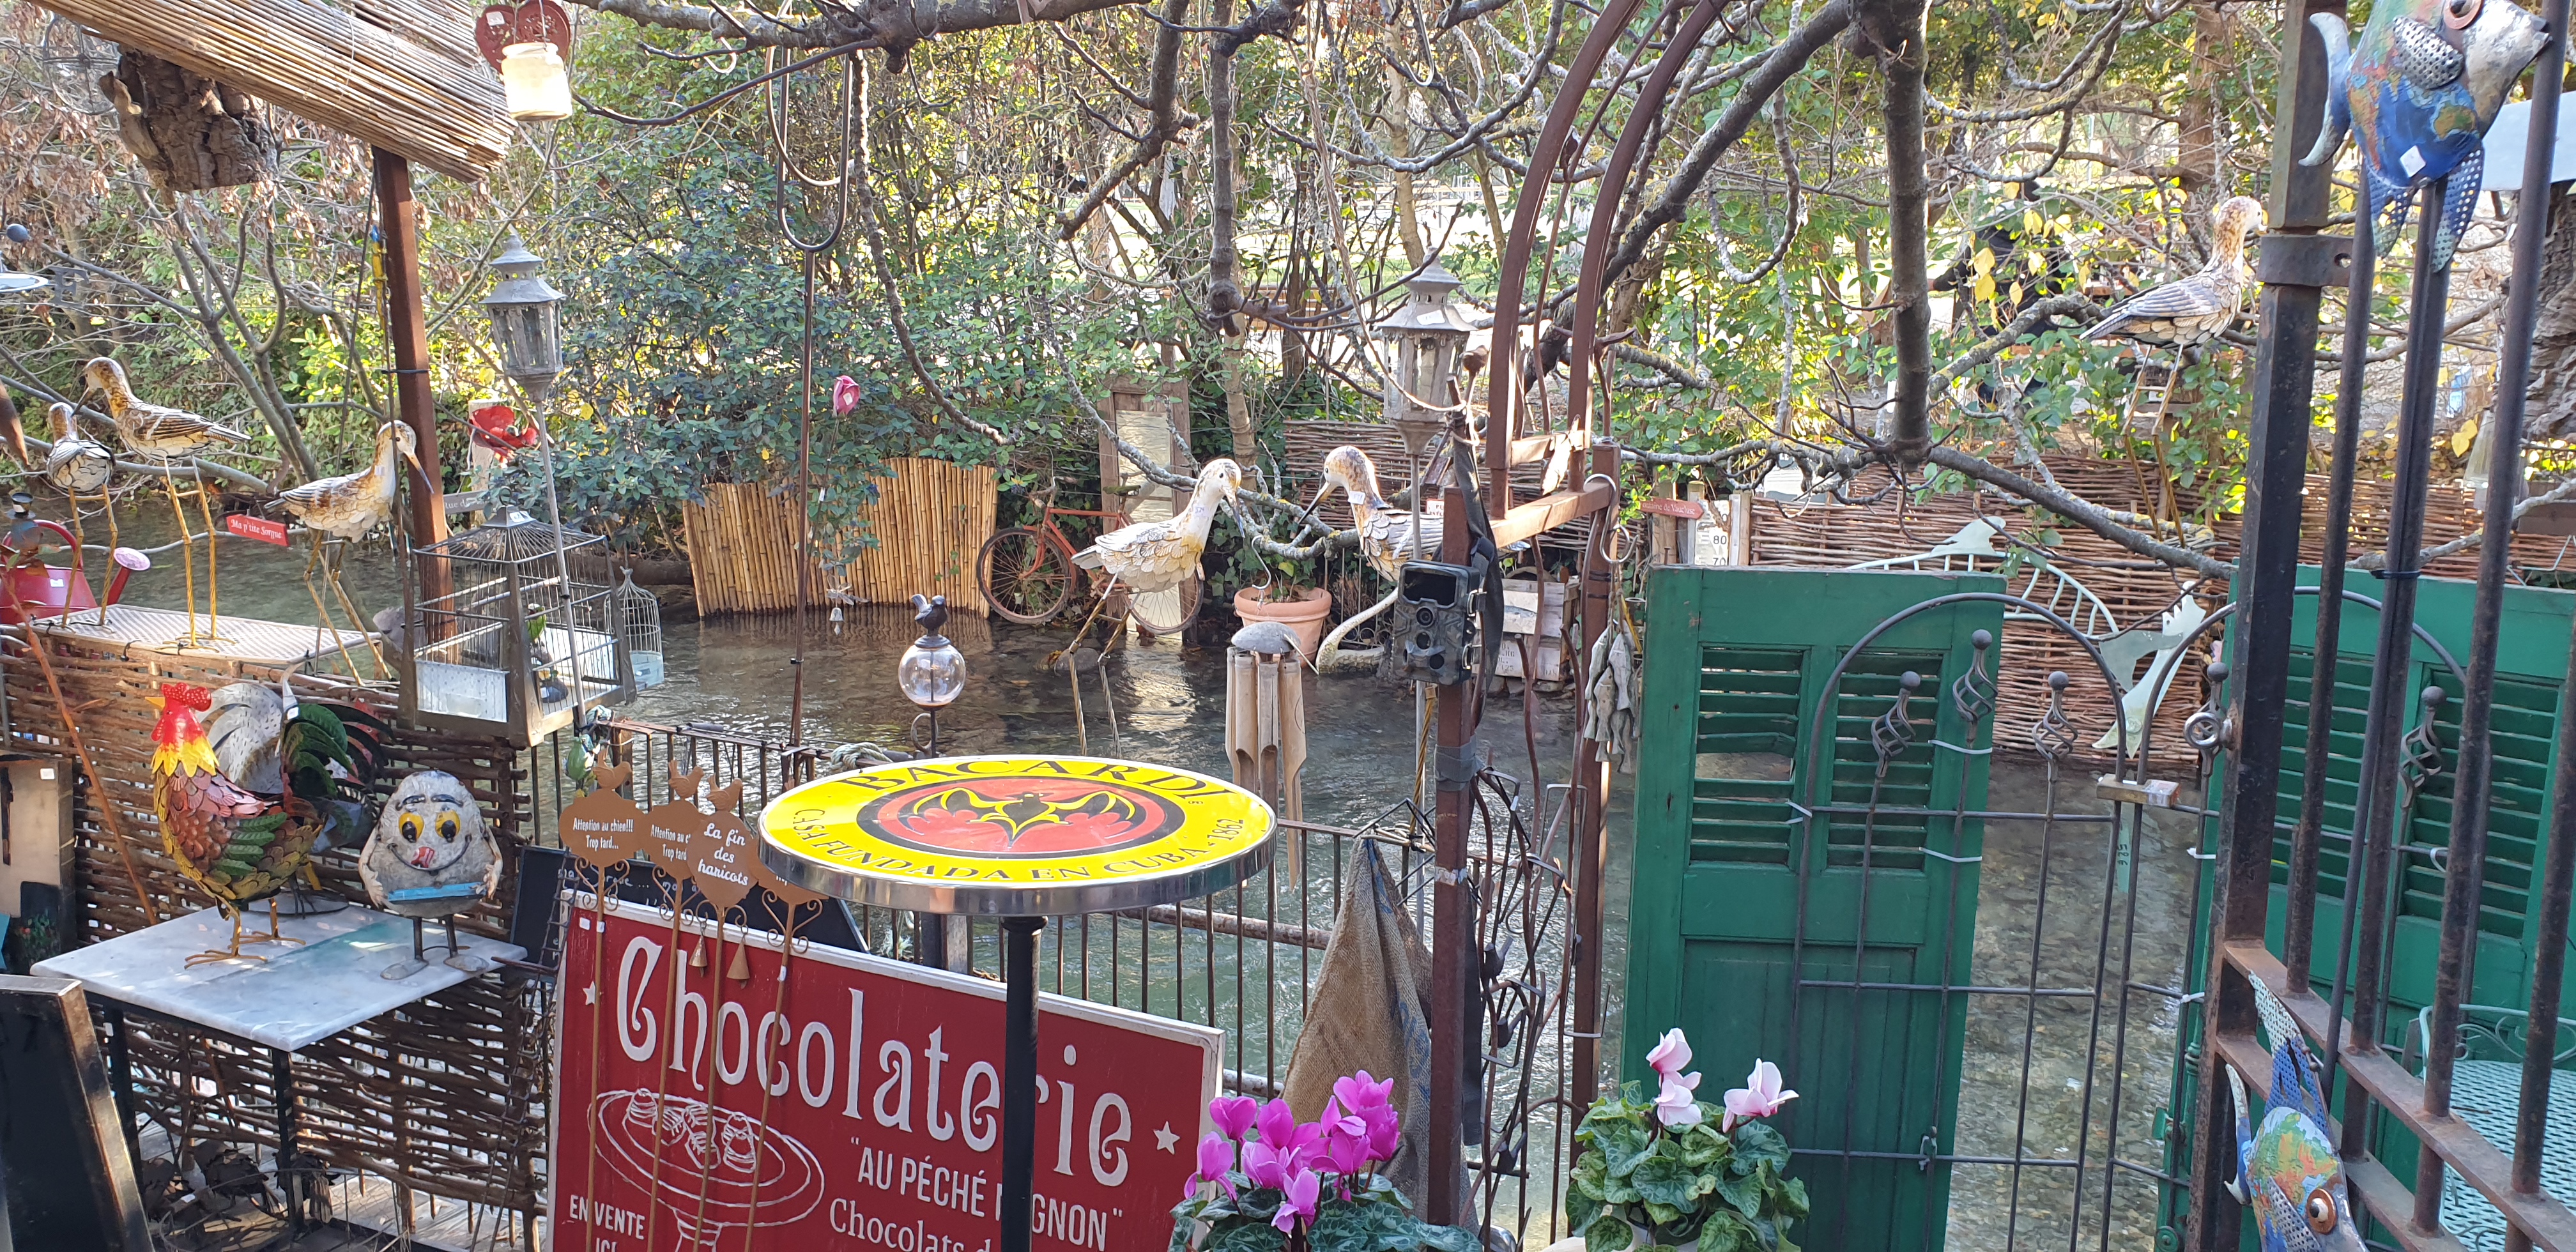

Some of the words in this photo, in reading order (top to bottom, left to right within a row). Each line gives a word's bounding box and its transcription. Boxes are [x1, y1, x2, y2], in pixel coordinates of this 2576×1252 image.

[1643, 502, 1662, 510] ontaine
[231, 519, 243, 530] Ma
[261, 526, 282, 540] Sorgue
[1713, 535, 1727, 545] 80
[1713, 557, 1726, 566] 70
[839, 760, 1238, 800] BACARDI
[572, 817, 600, 832] Attention
[602, 820, 609, 832] au
[610, 818, 634, 832] chien!!!
[650, 824, 676, 842] Attention
[677, 832, 685, 843] au
[703, 822, 723, 840] La
[725, 828, 746, 847] fin
[586, 834, 599, 852] Trop
[601, 836, 619, 850] tard...
[662, 843, 675, 862] Trop
[792, 809, 829, 841] CASA
[811, 839, 1013, 881] FUNDADA
[1031, 866, 1092, 880] EN
[1103, 847, 1211, 874] CUBA
[1206, 818, 1244, 841] 1862
[714, 846, 735, 864] des
[698, 858, 749, 887] haricots
[617, 936, 1132, 1187] Chocolateie
[900, 1154, 987, 1218] PÉCHÉ
[995, 1182, 1123, 1252] GNON"
[569, 1194, 589, 1223] EN
[594, 1200, 646, 1241] VENTE
